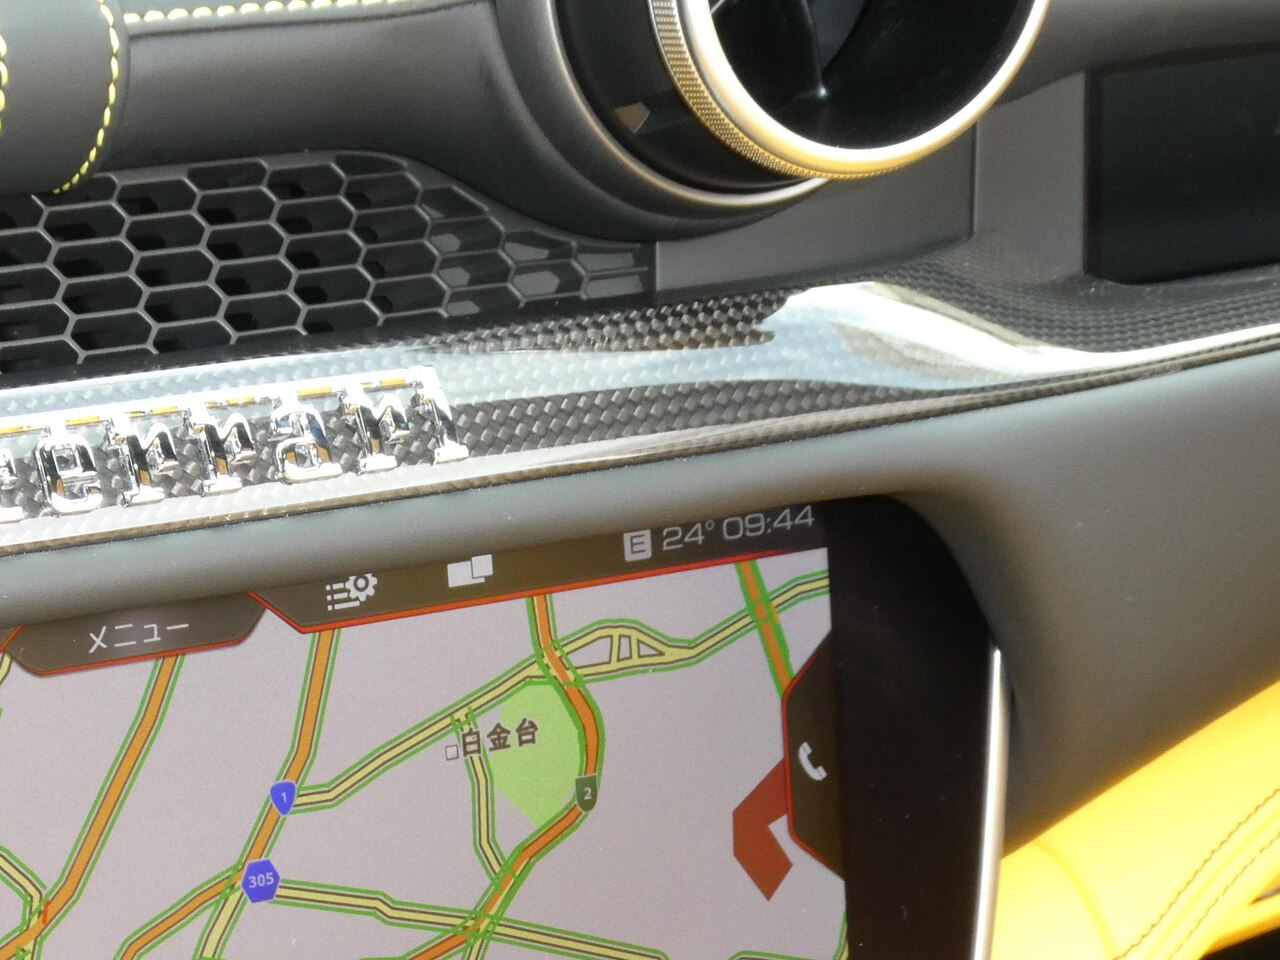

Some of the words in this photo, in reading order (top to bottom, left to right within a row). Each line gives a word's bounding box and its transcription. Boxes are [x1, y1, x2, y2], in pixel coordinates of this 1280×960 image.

[722, 505, 815, 541] 09:44
[88, 623, 190, 654] メニュー
[461, 717, 539, 757] 白金台
[280, 792, 288, 803] 1
[583, 785, 593, 801] 2
[248, 872, 275, 889] 305
